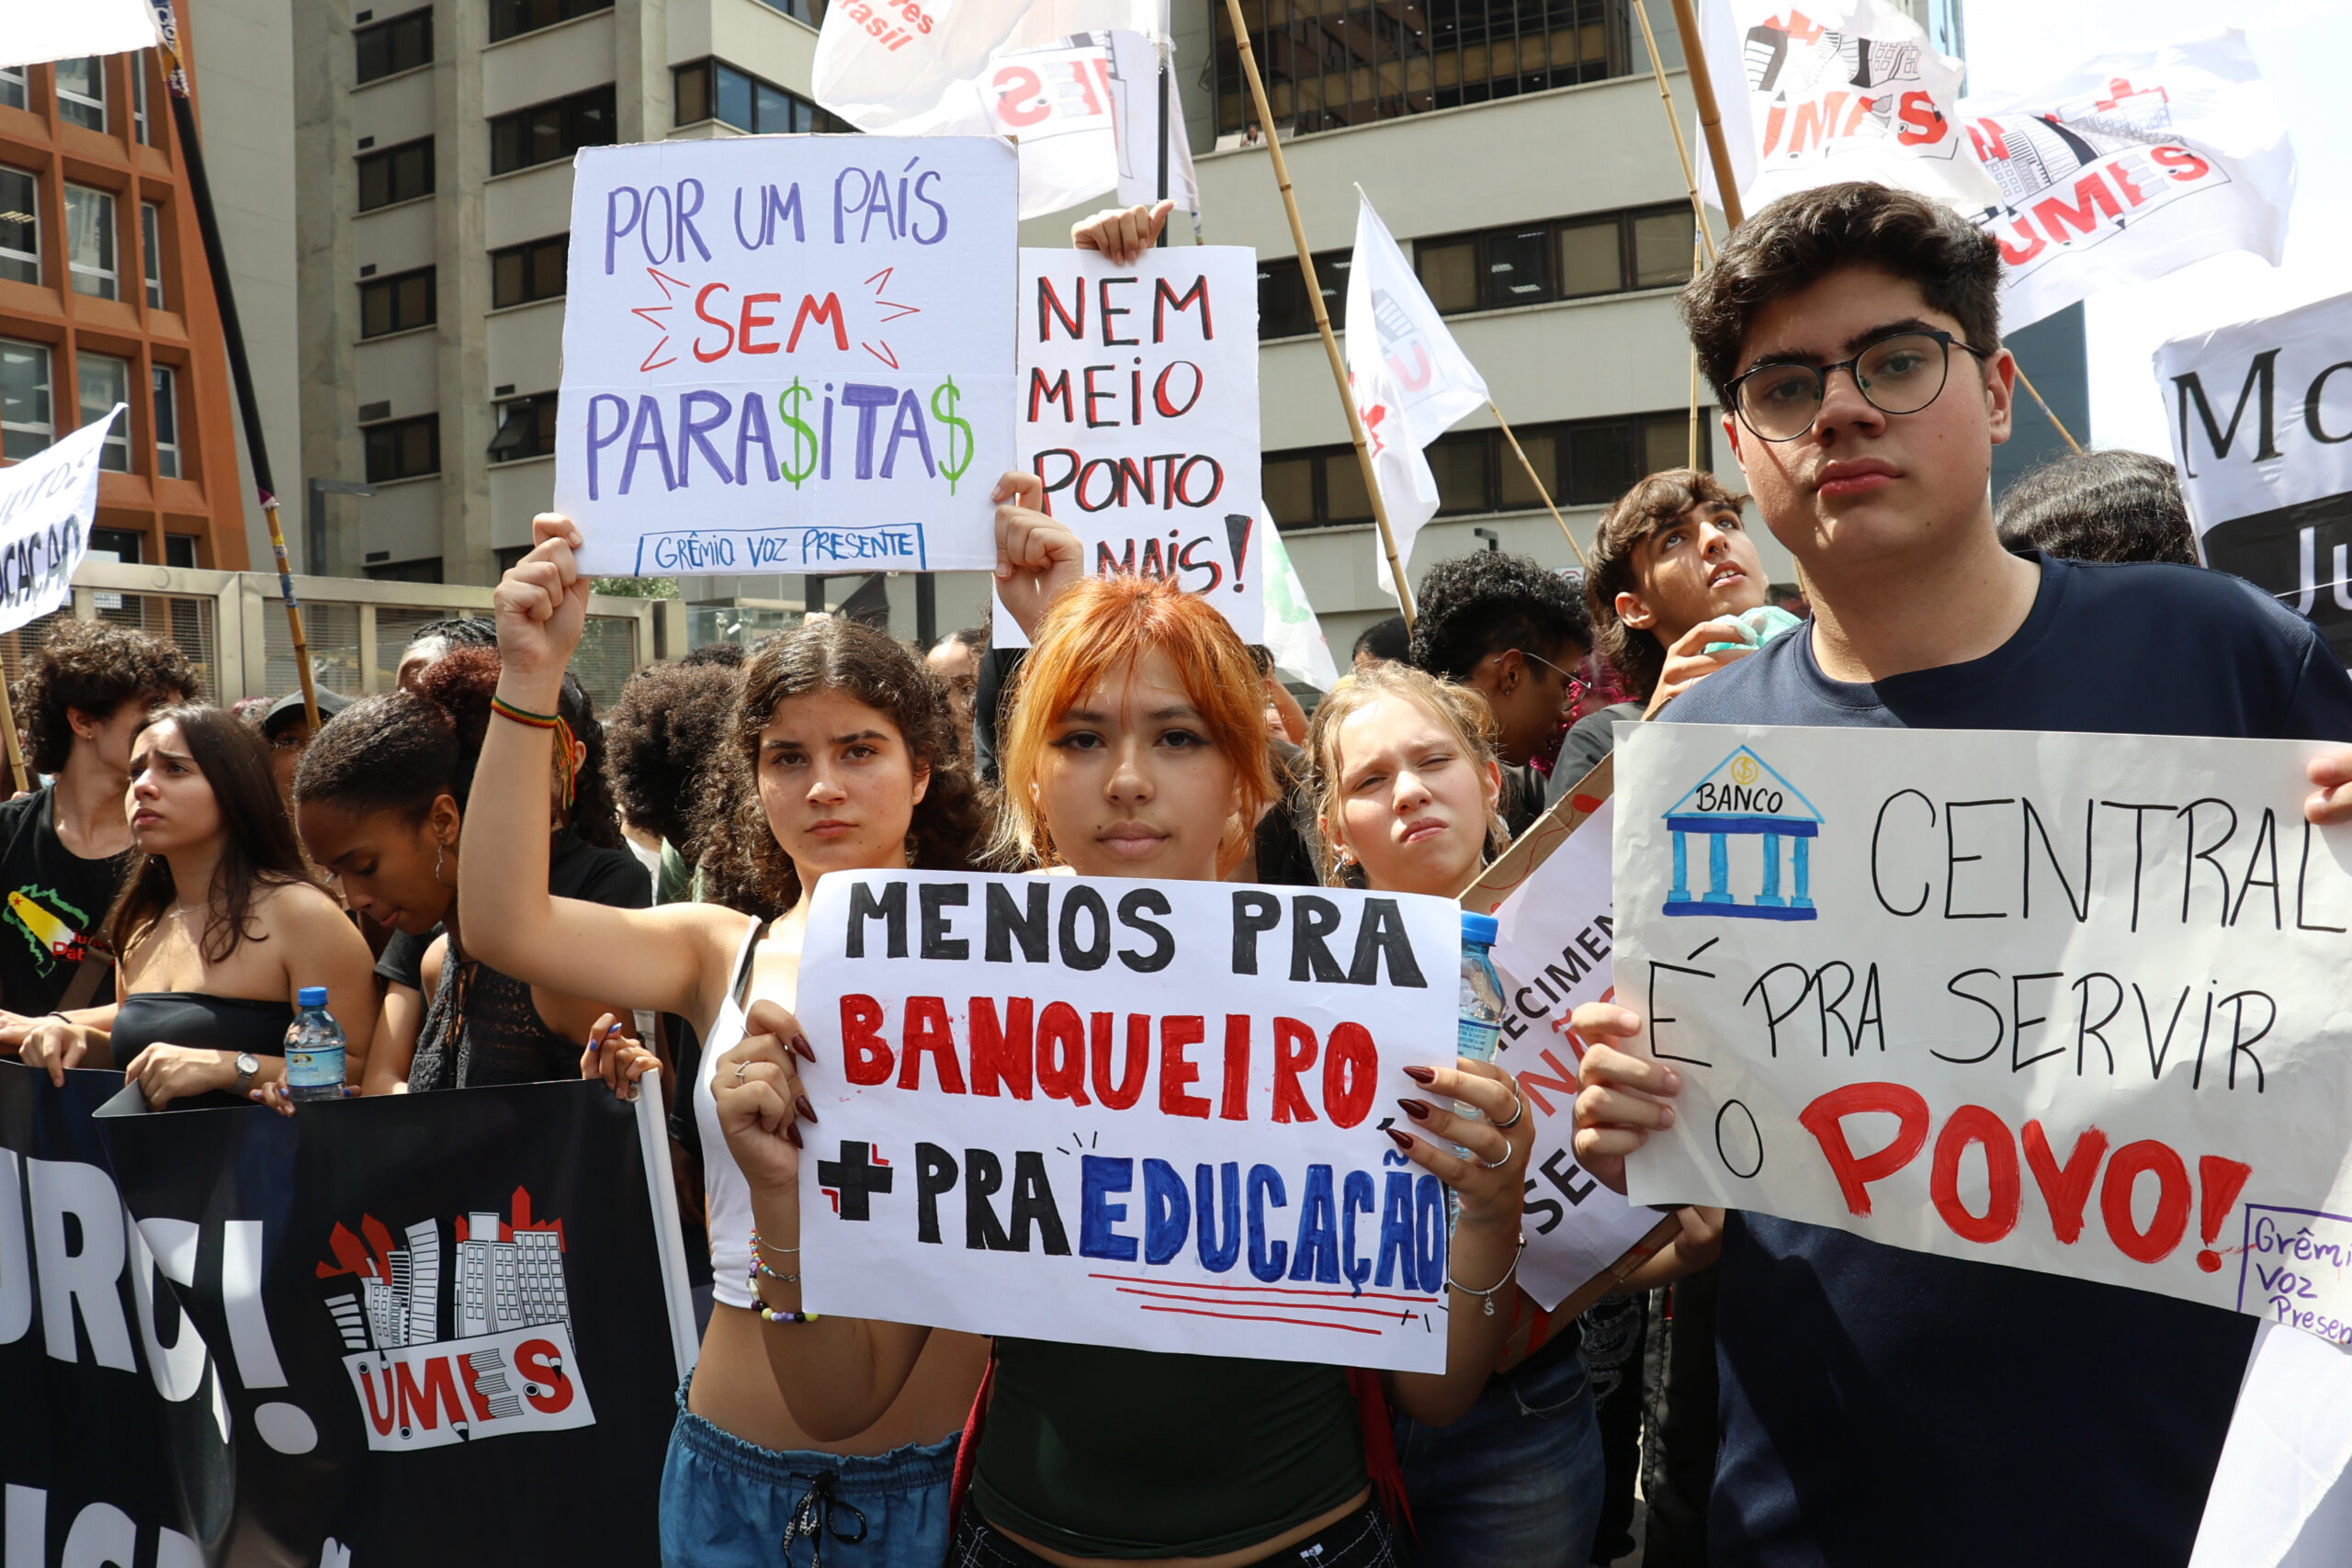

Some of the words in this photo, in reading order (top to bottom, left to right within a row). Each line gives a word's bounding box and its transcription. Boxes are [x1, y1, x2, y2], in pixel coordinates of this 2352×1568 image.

[834, 0, 913, 51] rasil
[605, 177, 712, 275] POR
[734, 182, 806, 250] UM
[833, 155, 948, 244] PAÍS
[693, 282, 850, 363] SEM
[1037, 274, 1214, 347] NEM
[1033, 447, 1225, 517] PONTO
[747, 536, 788, 568] VOZ
[802, 528, 914, 565] PRESENTE
[1696, 782, 1783, 814] BANCO
[1871, 787, 2347, 933] CENTRAL
[845, 881, 1176, 974] MENOS
[1232, 890, 1429, 989] PRA
[1650, 937, 1720, 1067] É
[1744, 960, 1885, 1058] PRA
[914, 1141, 1073, 1257] PRA
[1714, 1099, 1764, 1179] O
[1798, 1081, 2254, 1273] POVO!
[357, 1339, 574, 1440] UMES
